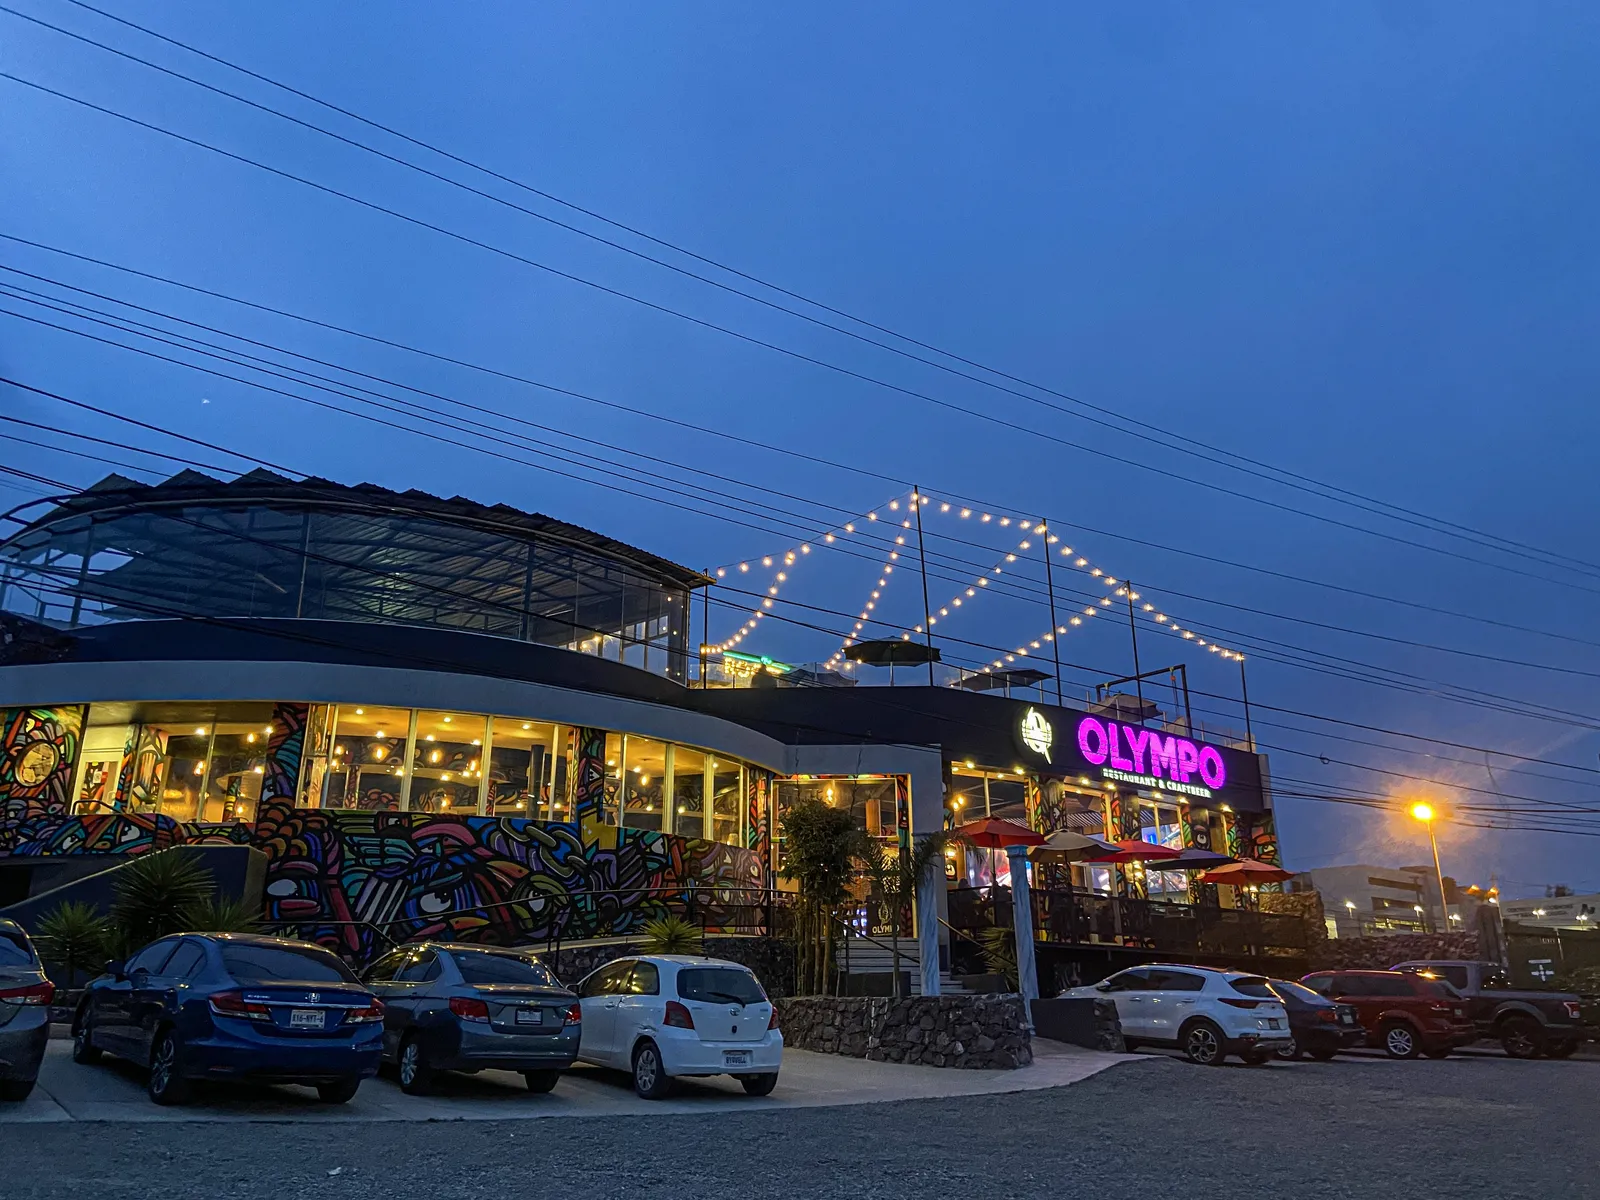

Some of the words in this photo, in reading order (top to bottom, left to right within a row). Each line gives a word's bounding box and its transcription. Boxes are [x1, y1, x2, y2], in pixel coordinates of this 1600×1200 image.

[1078, 717, 1225, 789] OLYMPO
[1103, 768, 1157, 787] RESTAURANT
[1158, 779, 1166, 789] &
[1167, 781, 1212, 798] CRAFTBEER
